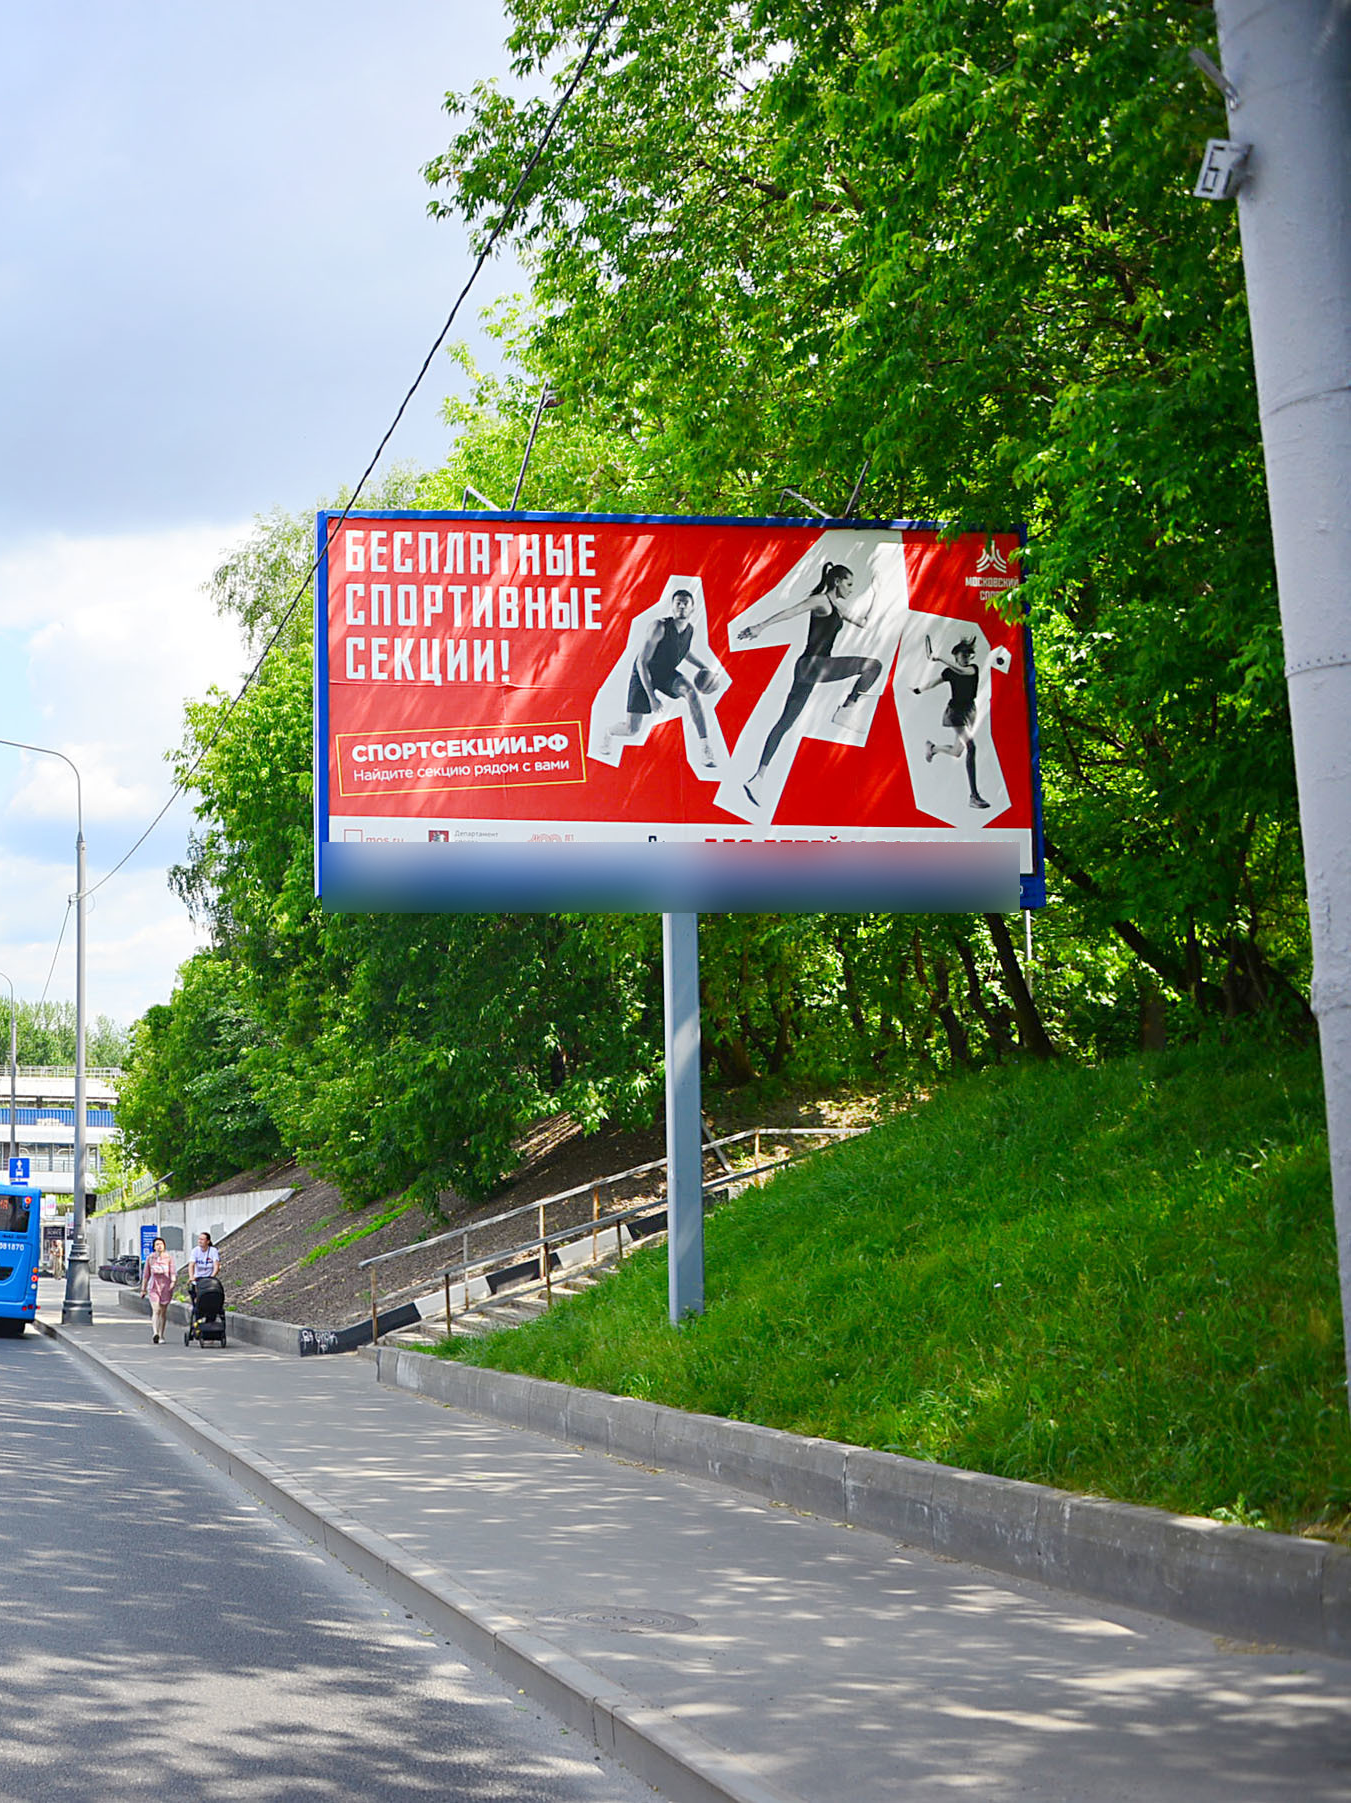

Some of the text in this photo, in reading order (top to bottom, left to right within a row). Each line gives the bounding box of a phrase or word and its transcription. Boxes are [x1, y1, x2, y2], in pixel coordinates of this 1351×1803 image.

[345, 530, 597, 576] БЕСПЛАТНЫЕ
[965, 576, 1020, 588] МОСКОВСКИЙ
[345, 583, 602, 630] СПОРТИВНЫЕ
[345, 637, 510, 686] СЕКЦИИ!
[351, 733, 569, 763] СПОРТСЕКЦИИ.РФ
[353, 760, 570, 782] Найдите секцию рядом с вами
[454, 830, 498, 838] Департамент
